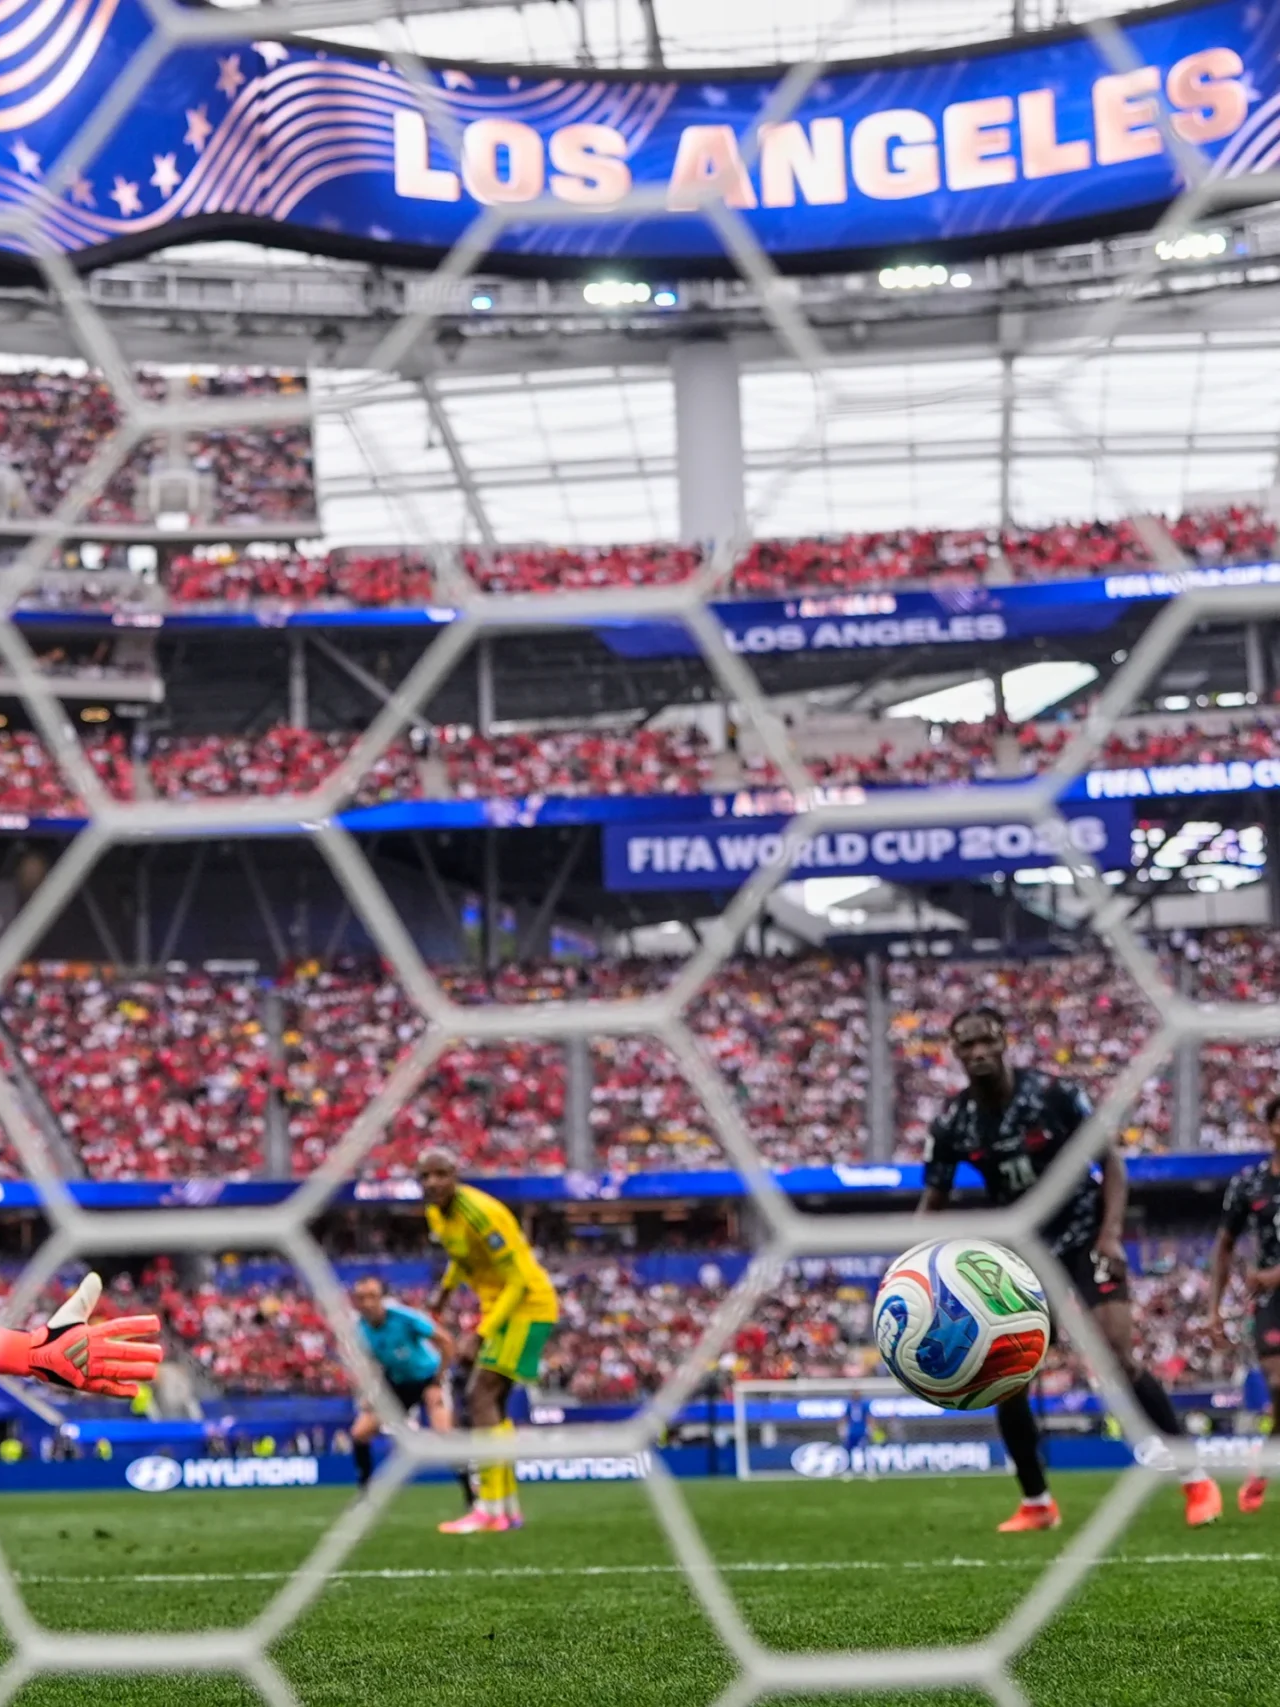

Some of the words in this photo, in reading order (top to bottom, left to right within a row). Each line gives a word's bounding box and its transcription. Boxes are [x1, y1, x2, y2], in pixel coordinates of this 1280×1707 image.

[393, 109, 631, 211] LOS
[666, 46, 1248, 211] ANGELES
[723, 623, 807, 654] LOS
[810, 613, 1008, 649] ANGELES
[1086, 768, 1151, 799] FIFA
[1148, 761, 1253, 794] WORLD
[626, 836, 718, 874] FIFA
[717, 831, 869, 870] WORLD
[871, 826, 957, 865] CUP
[958, 815, 1109, 861] 2026
[183, 1456, 319, 1487] HYUNDAI
[515, 1452, 652, 1481] HYUNDAI
[851, 1442, 991, 1473] HYUNDAI
